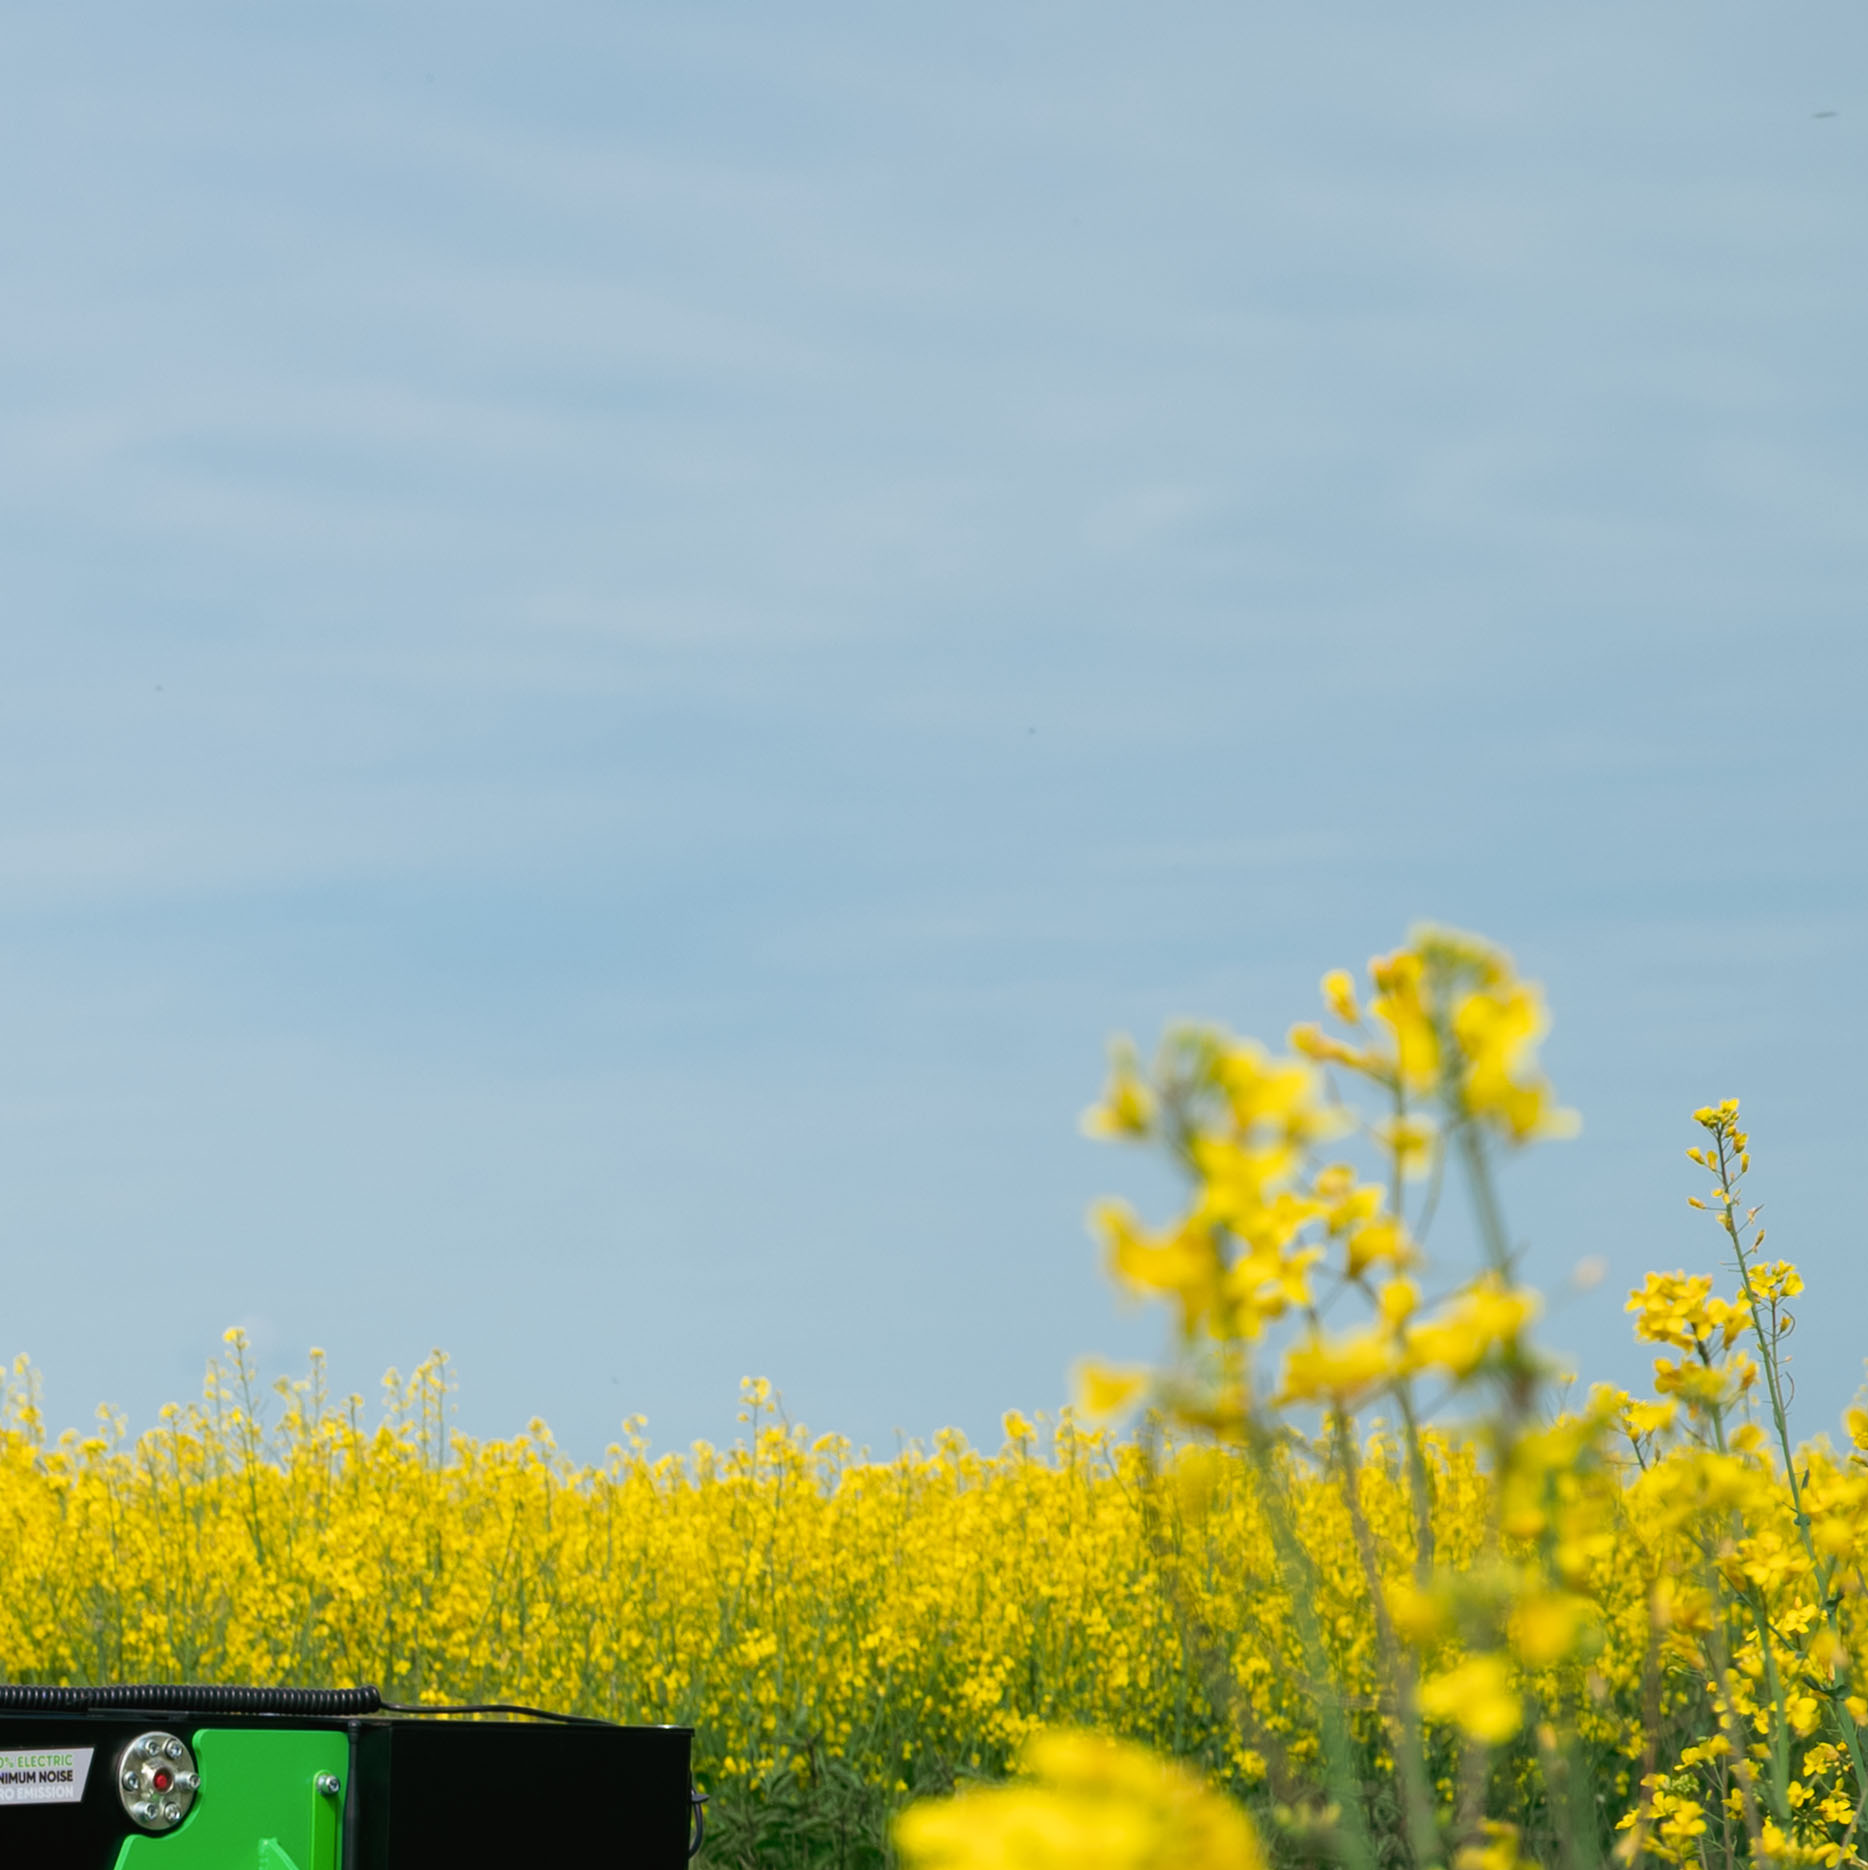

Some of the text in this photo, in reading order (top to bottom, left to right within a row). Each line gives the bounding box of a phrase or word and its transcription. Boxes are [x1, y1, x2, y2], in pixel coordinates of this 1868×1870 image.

[17, 1754, 73, 1768] ELECTRIC
[39, 1769, 73, 1783] NOISE
[18, 1785, 74, 1800] EMISSION
